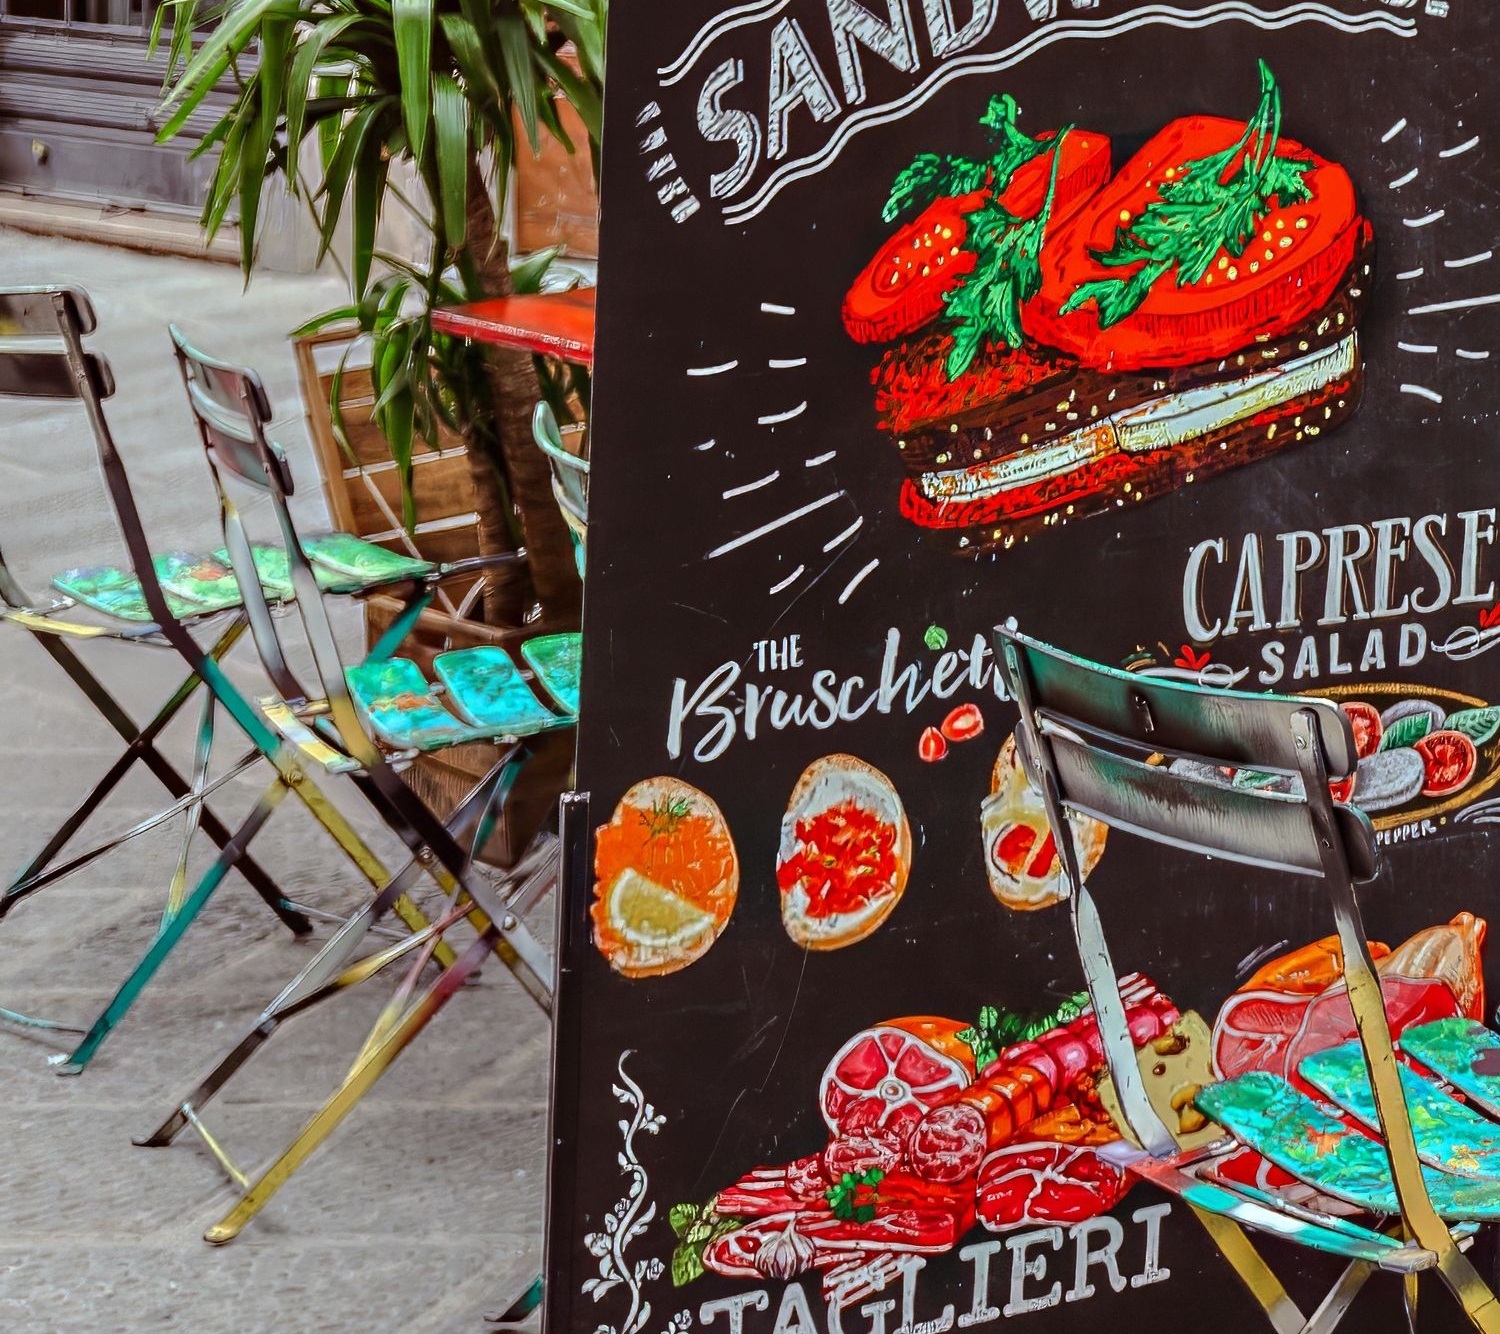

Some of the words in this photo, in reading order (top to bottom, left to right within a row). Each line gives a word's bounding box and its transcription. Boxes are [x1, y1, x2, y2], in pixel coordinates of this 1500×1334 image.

[1182, 507, 1498, 643] CAPRESE
[666, 627, 1019, 763] Bruschet
[753, 633, 804, 673] THE
[1258, 623, 1428, 685] SALAD
